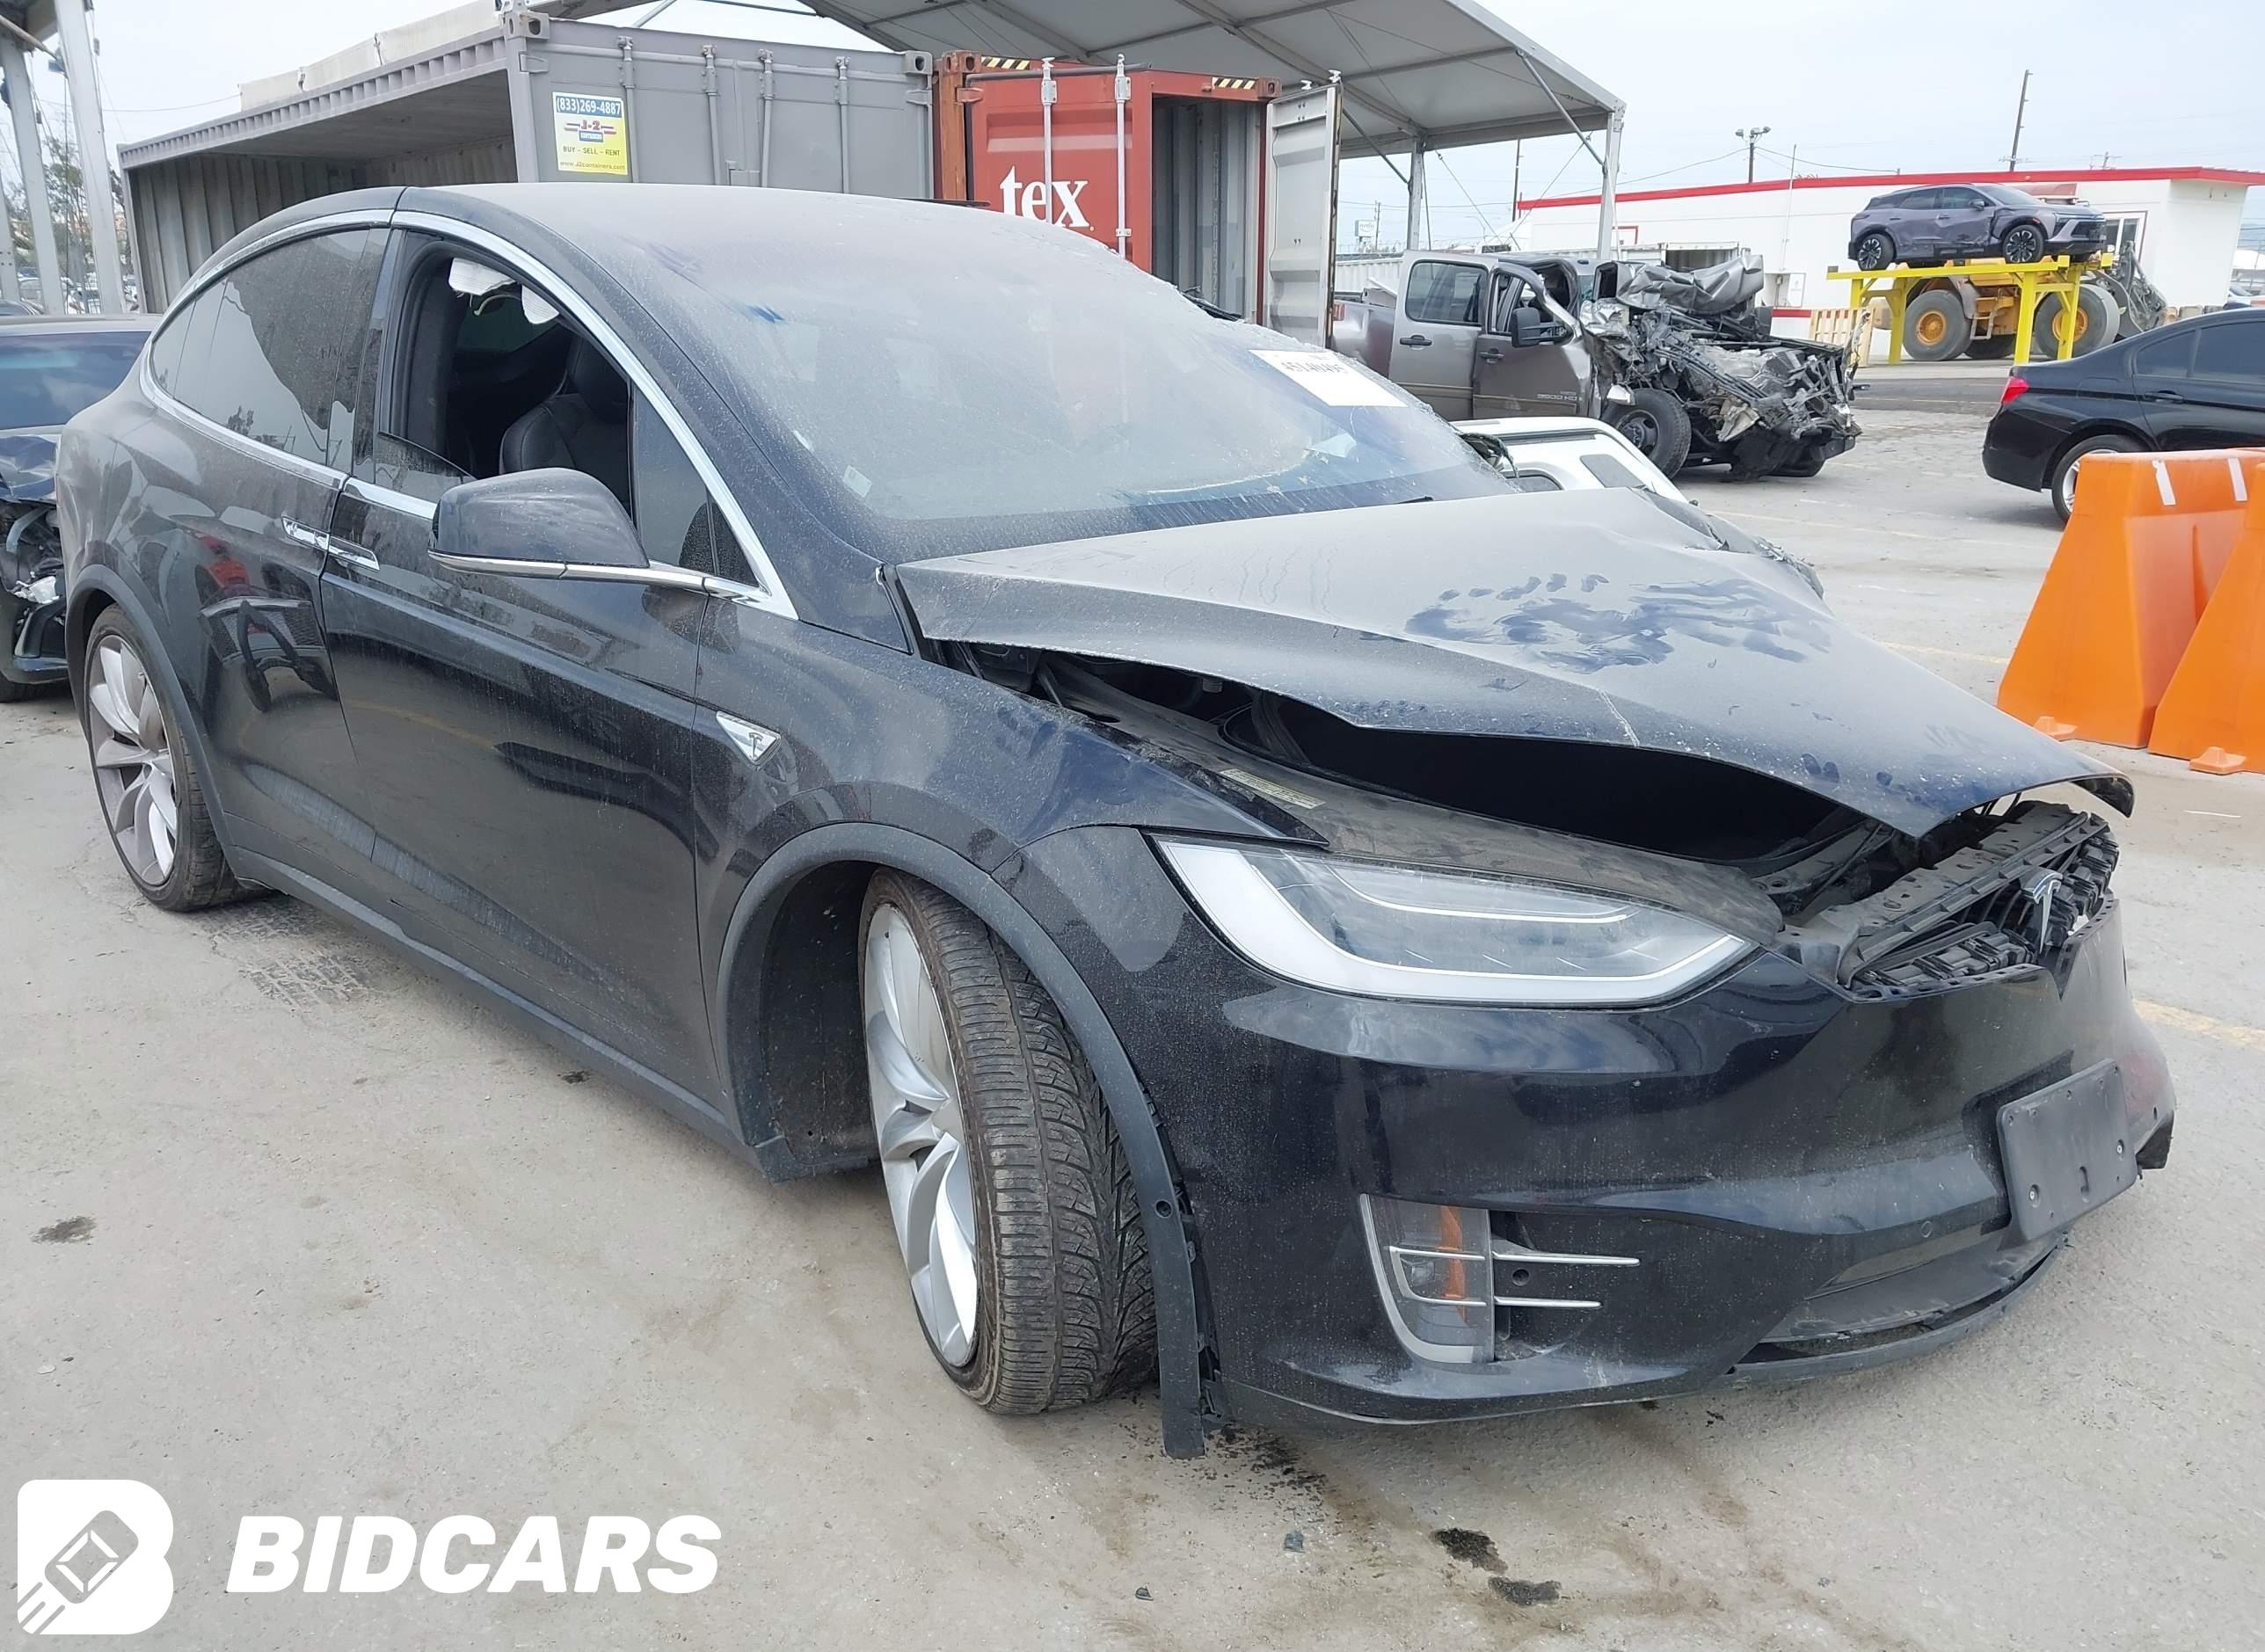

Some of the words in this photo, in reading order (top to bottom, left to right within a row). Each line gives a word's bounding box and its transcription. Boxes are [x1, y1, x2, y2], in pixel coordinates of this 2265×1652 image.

[557, 97, 621, 115] (833)269-4887
[580, 120, 601, 130] J-2
[1000, 165, 1089, 228] tex
